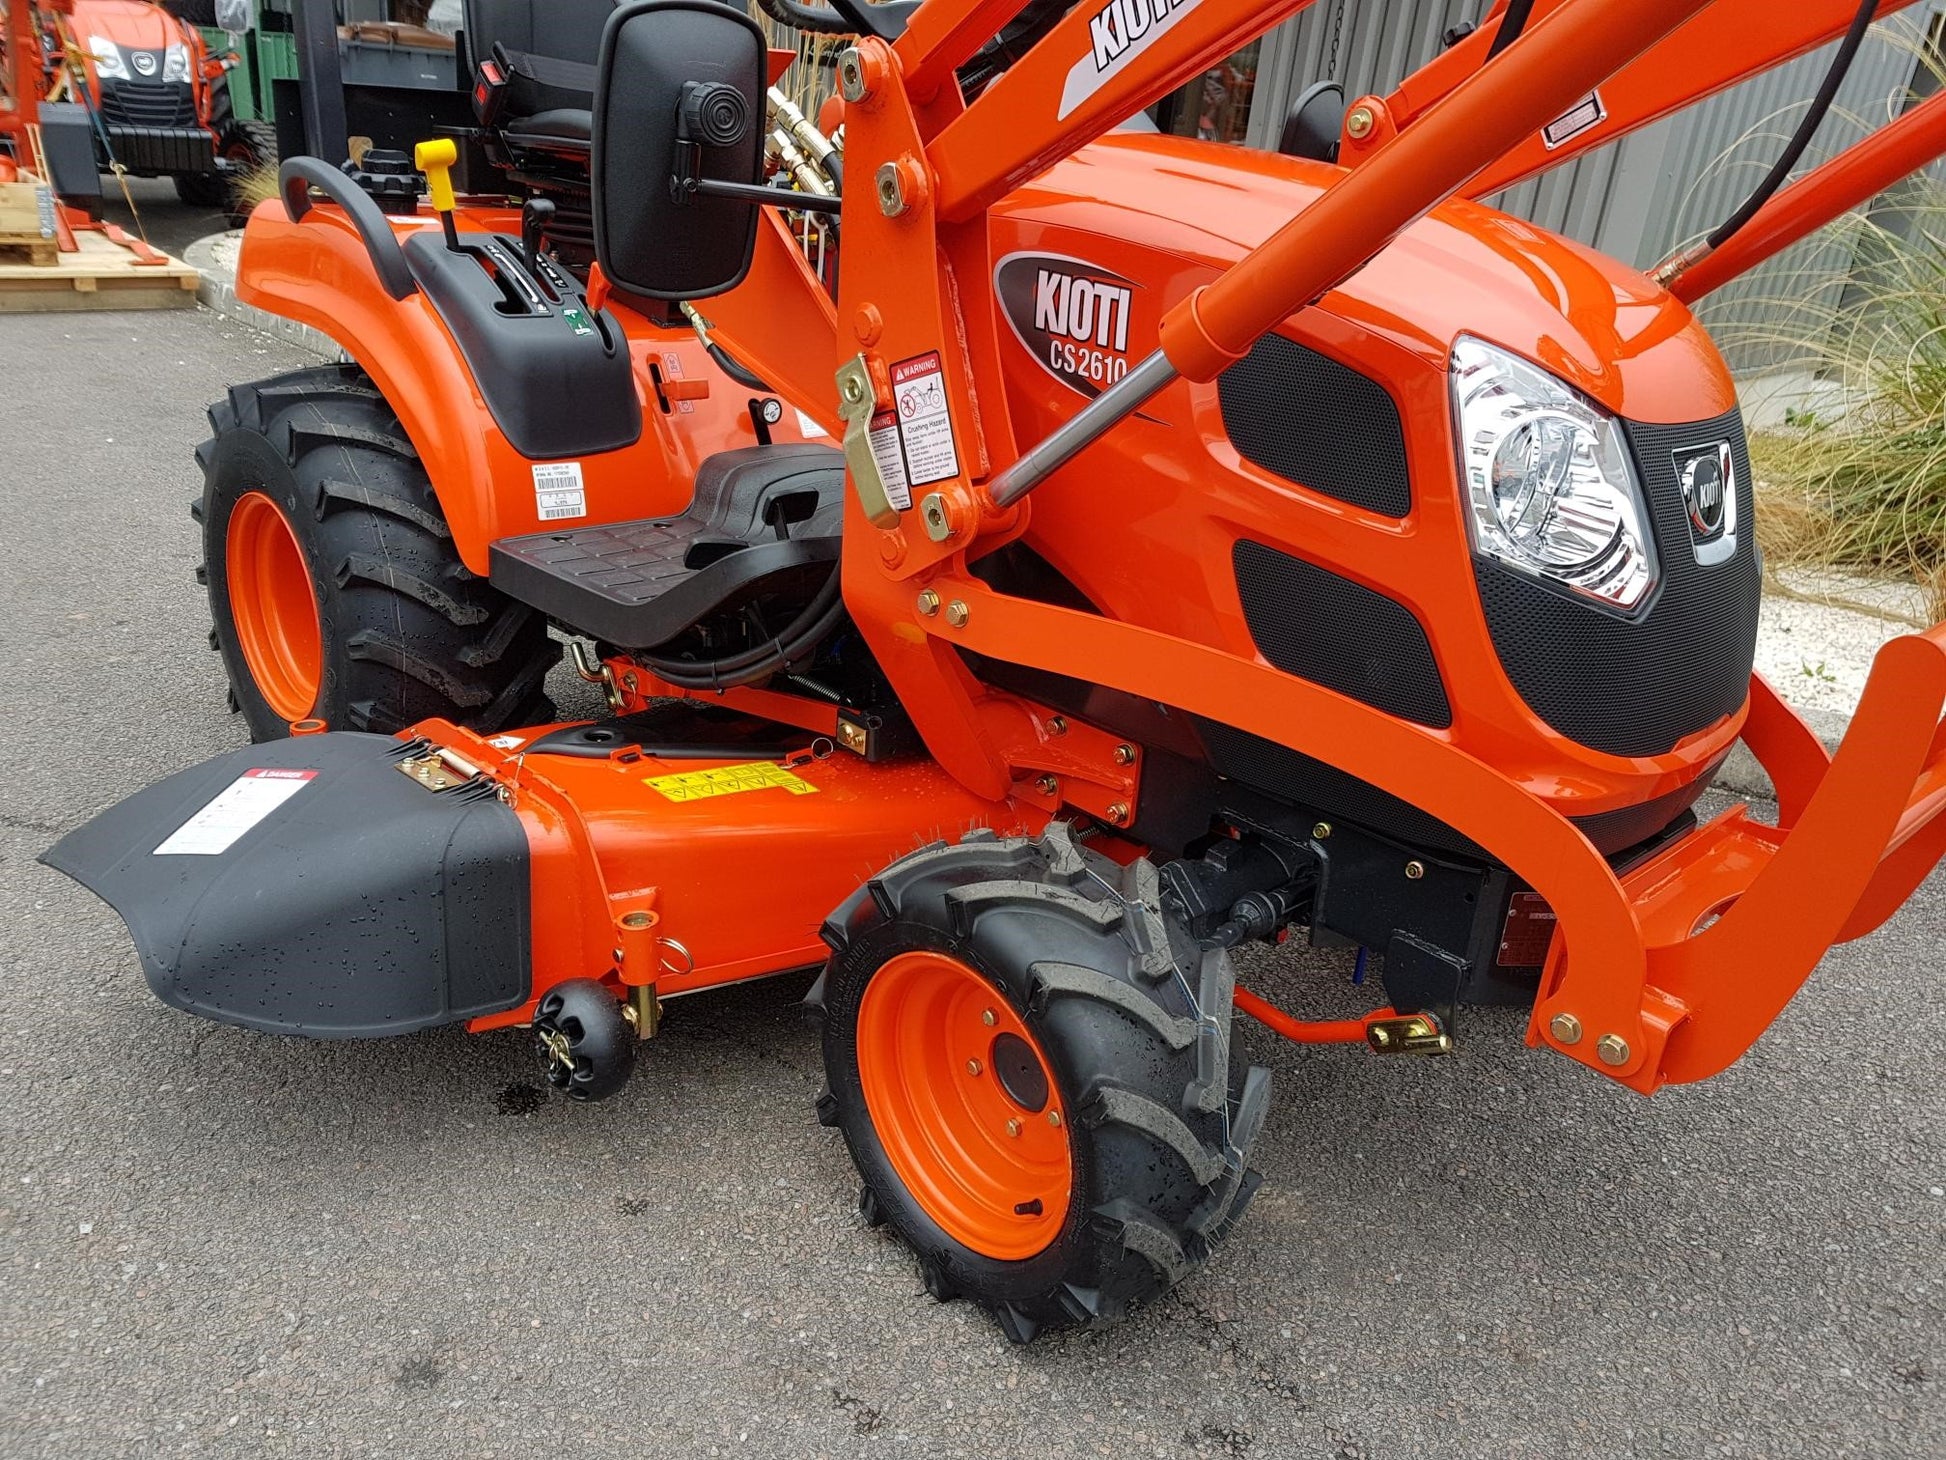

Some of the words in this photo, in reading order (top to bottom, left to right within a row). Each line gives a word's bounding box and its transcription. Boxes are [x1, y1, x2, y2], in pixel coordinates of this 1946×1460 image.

[1089, 0, 1185, 73] KIO
[1035, 268, 1132, 353] KIOTI
[903, 359, 936, 377] WARNING
[1050, 339, 1128, 385] CS2610
[907, 422, 929, 434] Crushing
[929, 417, 947, 428] Hazard
[1700, 480, 1721, 509] KIOTI
